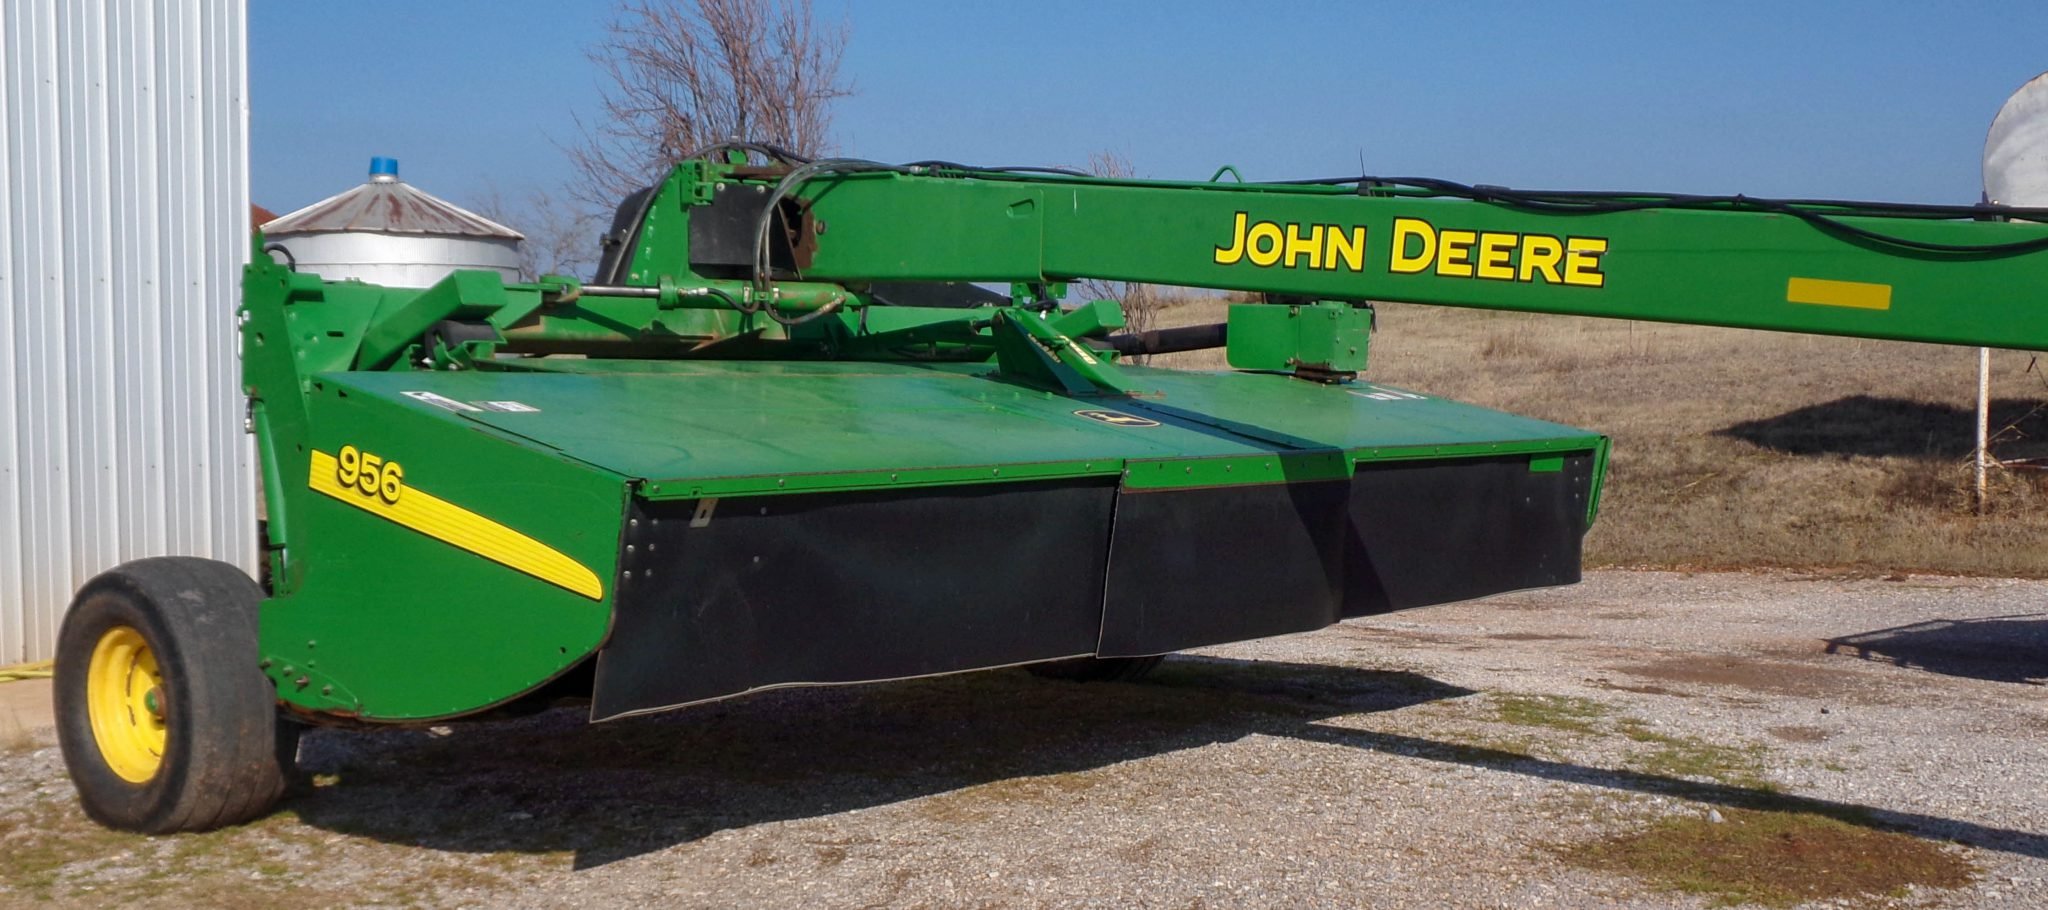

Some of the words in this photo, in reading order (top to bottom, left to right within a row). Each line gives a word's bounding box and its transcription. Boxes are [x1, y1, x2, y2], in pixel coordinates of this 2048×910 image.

[1214, 211, 1367, 272] JOHN
[1389, 216, 1608, 288] DEERE
[338, 444, 403, 505] 956
